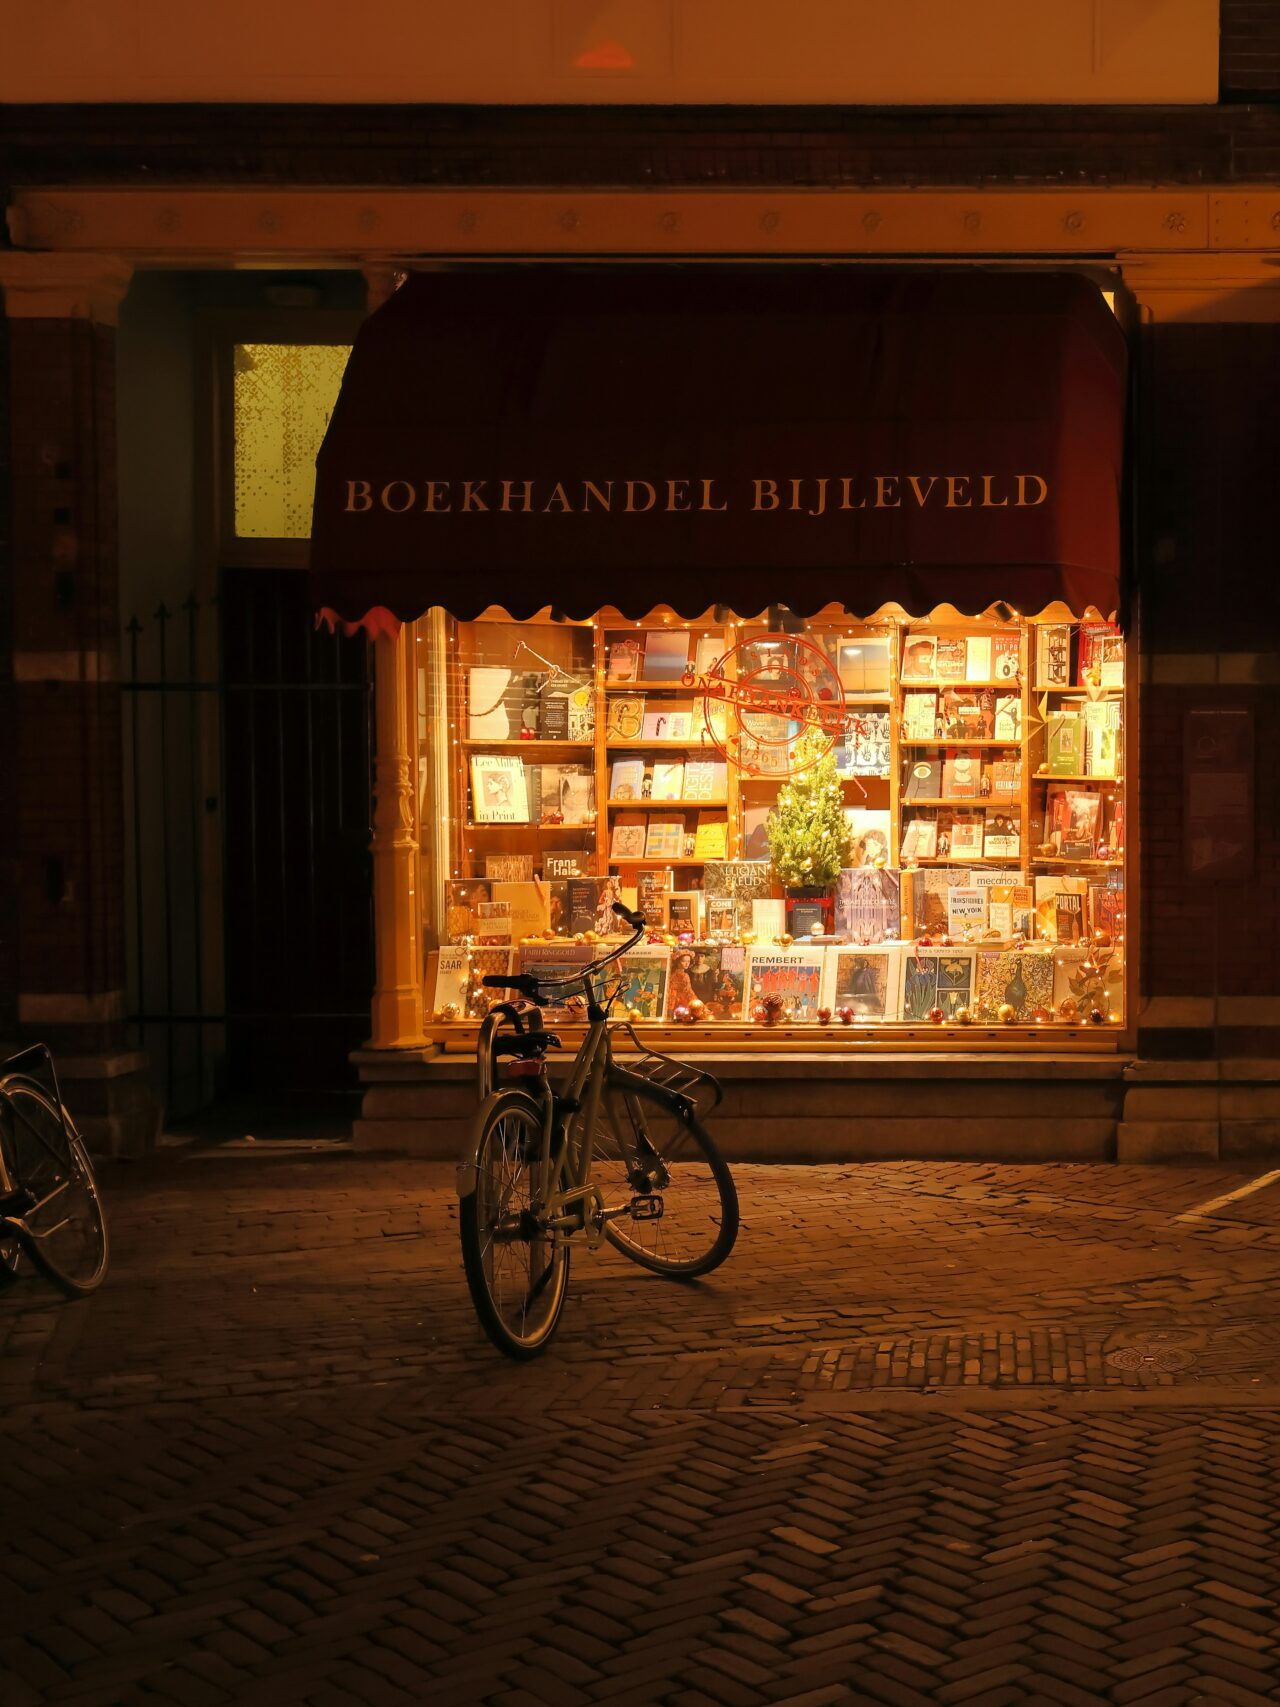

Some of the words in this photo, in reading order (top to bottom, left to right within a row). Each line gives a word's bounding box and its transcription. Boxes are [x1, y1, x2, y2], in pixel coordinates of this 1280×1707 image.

[344, 479, 729, 513] BOEKHANDEL
[751, 474, 1049, 516] BIJLEVELD
[475, 757, 493, 767] Lee
[479, 811, 489, 820] in
[492, 810, 516, 820] Print
[546, 857, 577, 870] Frans
[553, 866, 577, 876] Hals
[440, 960, 462, 970] SAAR
[752, 956, 804, 964] REMBERT
